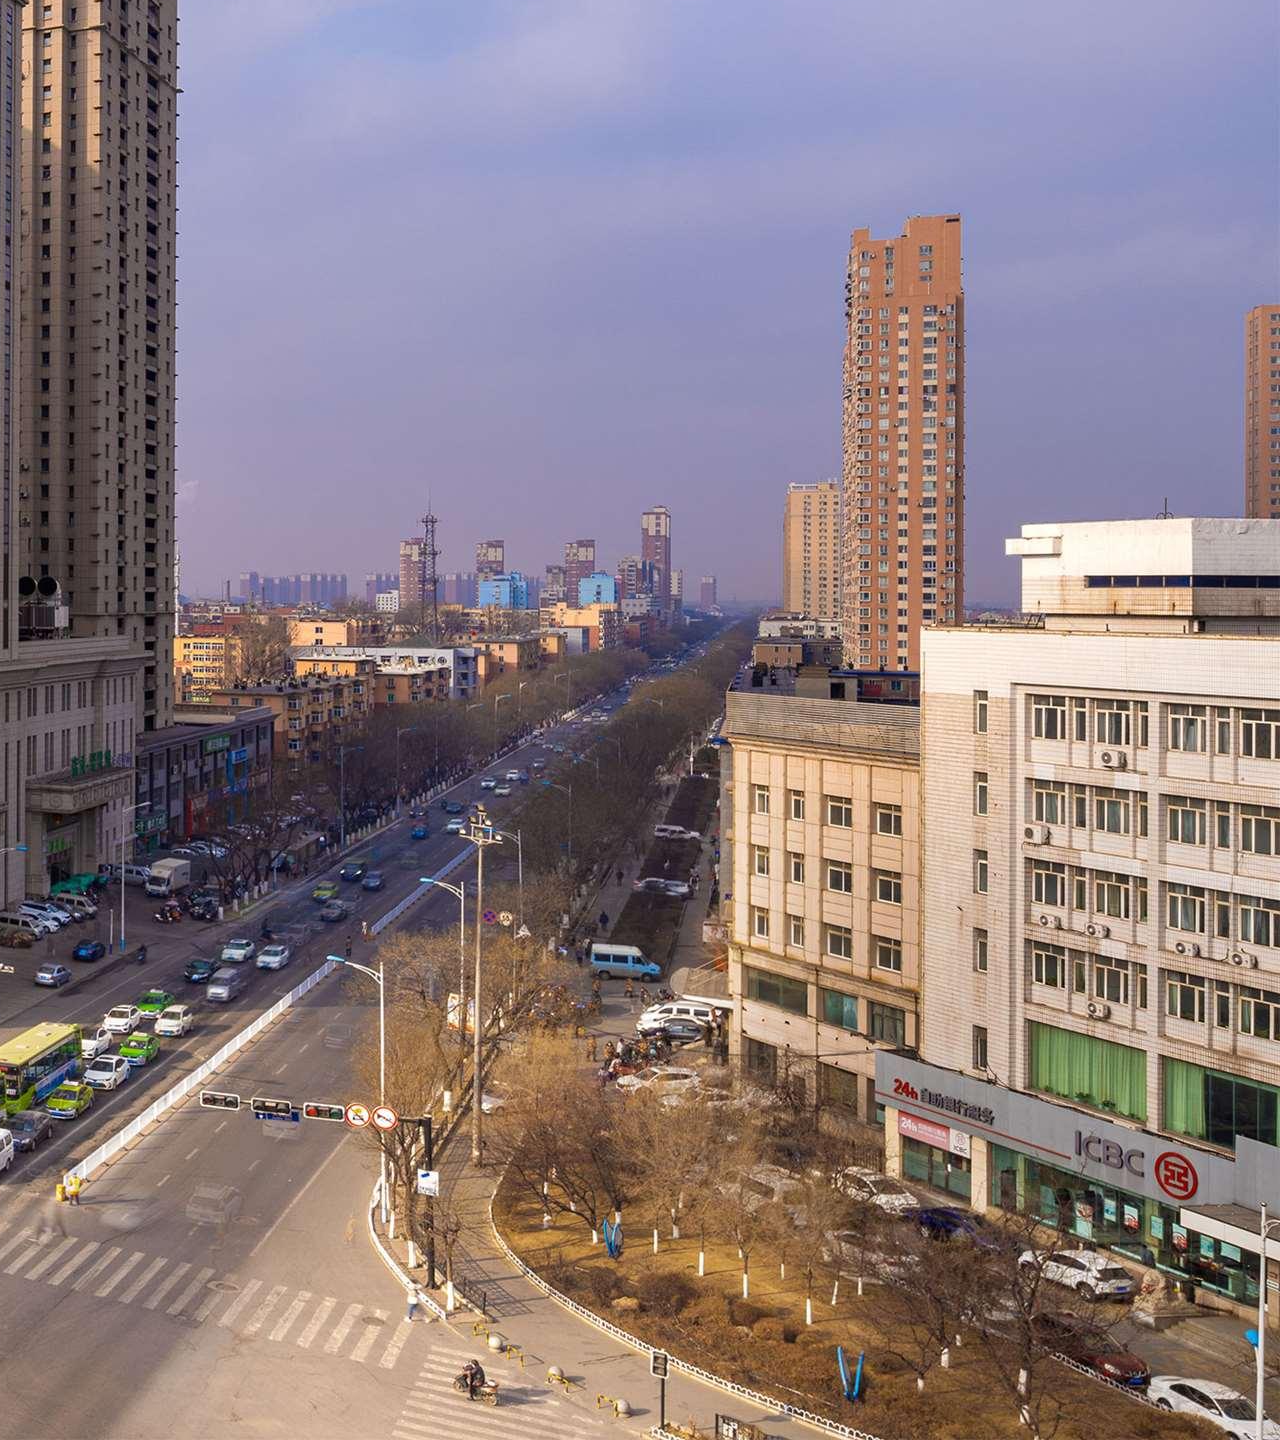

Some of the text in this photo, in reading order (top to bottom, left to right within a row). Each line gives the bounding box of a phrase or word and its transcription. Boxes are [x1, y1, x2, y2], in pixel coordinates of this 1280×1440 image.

[893, 1078, 996, 1126] 24h 自助银行服务
[1074, 1129, 1145, 1178] ICBC
